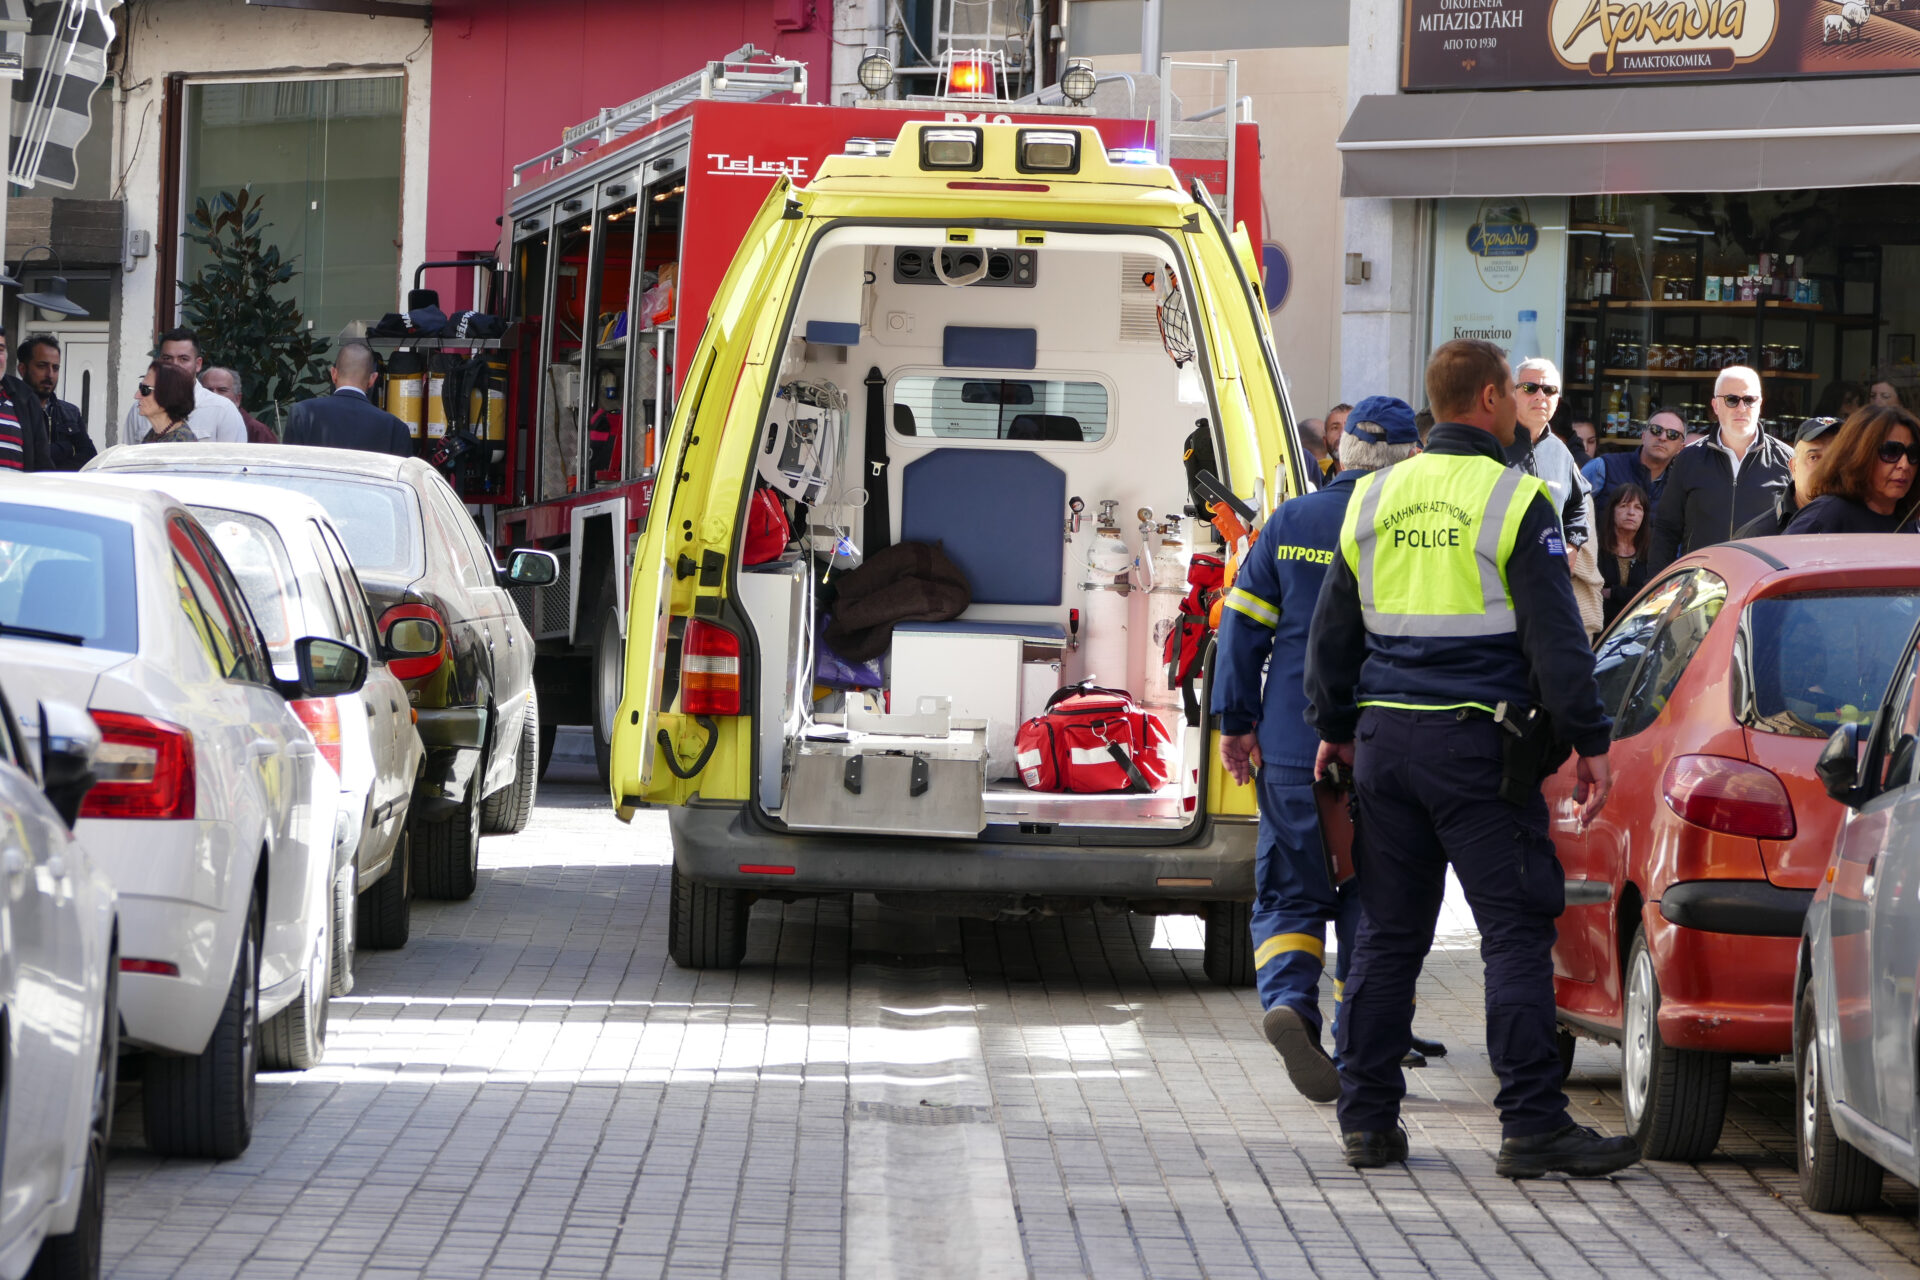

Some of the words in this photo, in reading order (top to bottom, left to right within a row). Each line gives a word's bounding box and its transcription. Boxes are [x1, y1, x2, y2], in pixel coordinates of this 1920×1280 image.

[1418, 9, 1524, 32] ΜΠΑΖΙΩΤΑΚΗ
[1443, 39, 1463, 50] ΑΠΟ
[1465, 38, 1478, 49] ΤΟ
[1479, 37, 1497, 49] 1930
[1623, 54, 1712, 69] ΓΑΛΑΚΤΟΚΟΜΙΚΑ
[1453, 325, 1512, 339] Κατσικίσιο
[1383, 502, 1429, 530] ΕΛΛΗΝΙΚΗ
[1429, 500, 1473, 528] ΑΣΤΥΝΟΜΙΑ
[1394, 528, 1460, 548] POLICE
